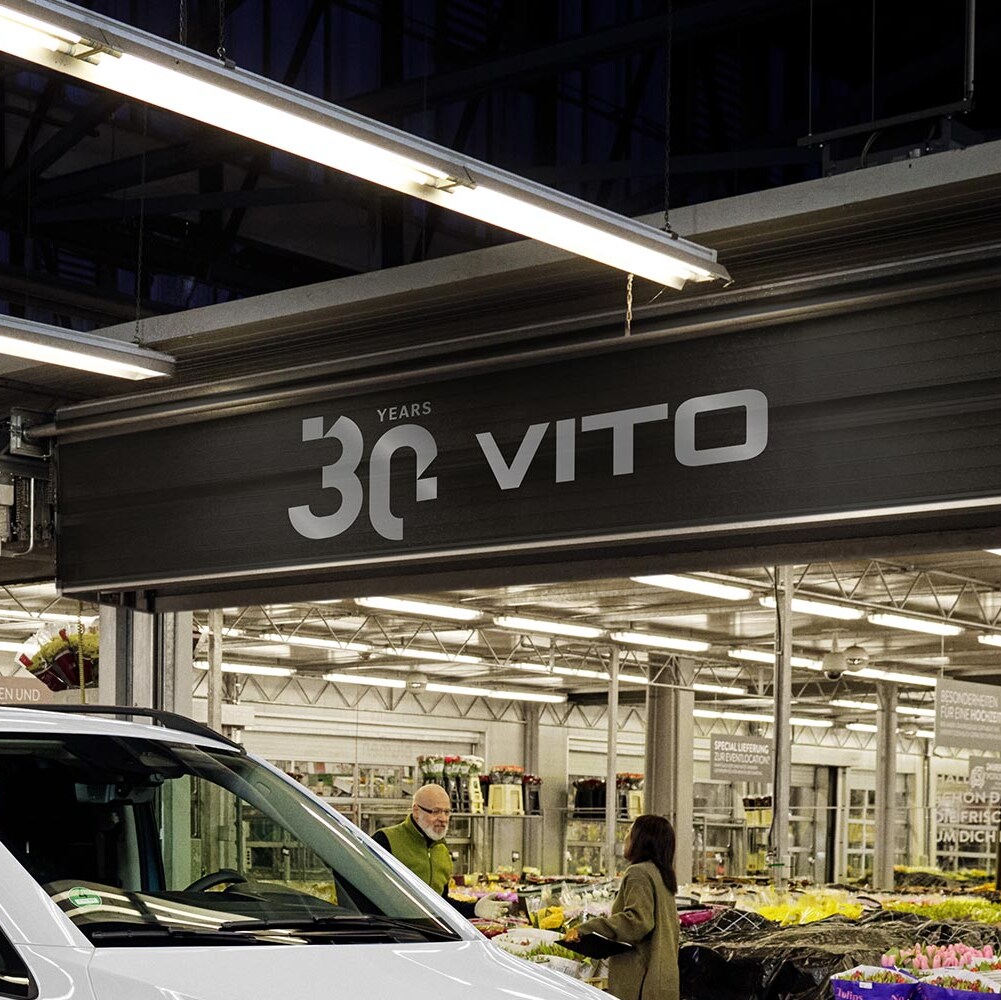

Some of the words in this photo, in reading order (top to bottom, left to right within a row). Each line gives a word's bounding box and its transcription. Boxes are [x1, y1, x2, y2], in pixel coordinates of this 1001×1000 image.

[376, 401, 432, 423] YEARS
[288, 415, 438, 541] 30
[475, 388, 769, 491] VITO
[15, 688, 41, 702] UND
[714, 740, 737, 752] SPECIAL
[738, 743, 769, 754] LIEFERUNG
[960, 830, 996, 843] DICH
